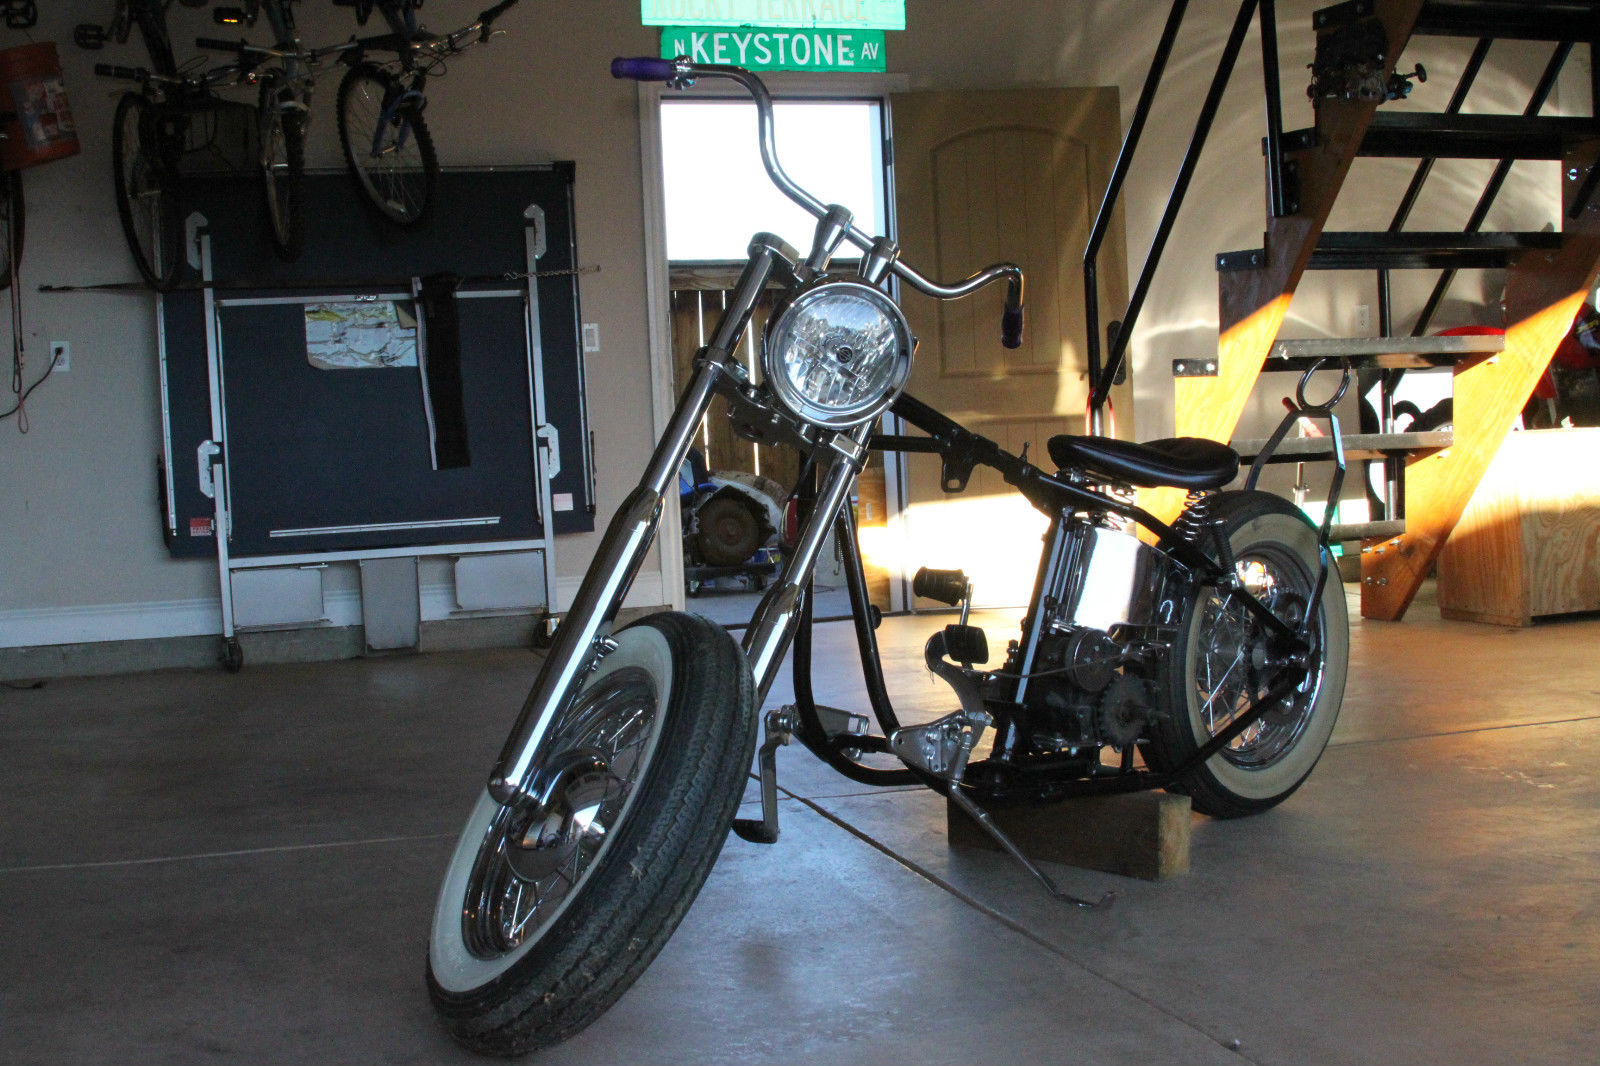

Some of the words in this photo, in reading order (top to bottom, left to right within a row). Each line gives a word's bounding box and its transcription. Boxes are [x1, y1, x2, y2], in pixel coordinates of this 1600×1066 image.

[674, 39, 685, 57] N
[691, 32, 855, 65] KEYSTONE
[861, 42, 879, 60] AV
